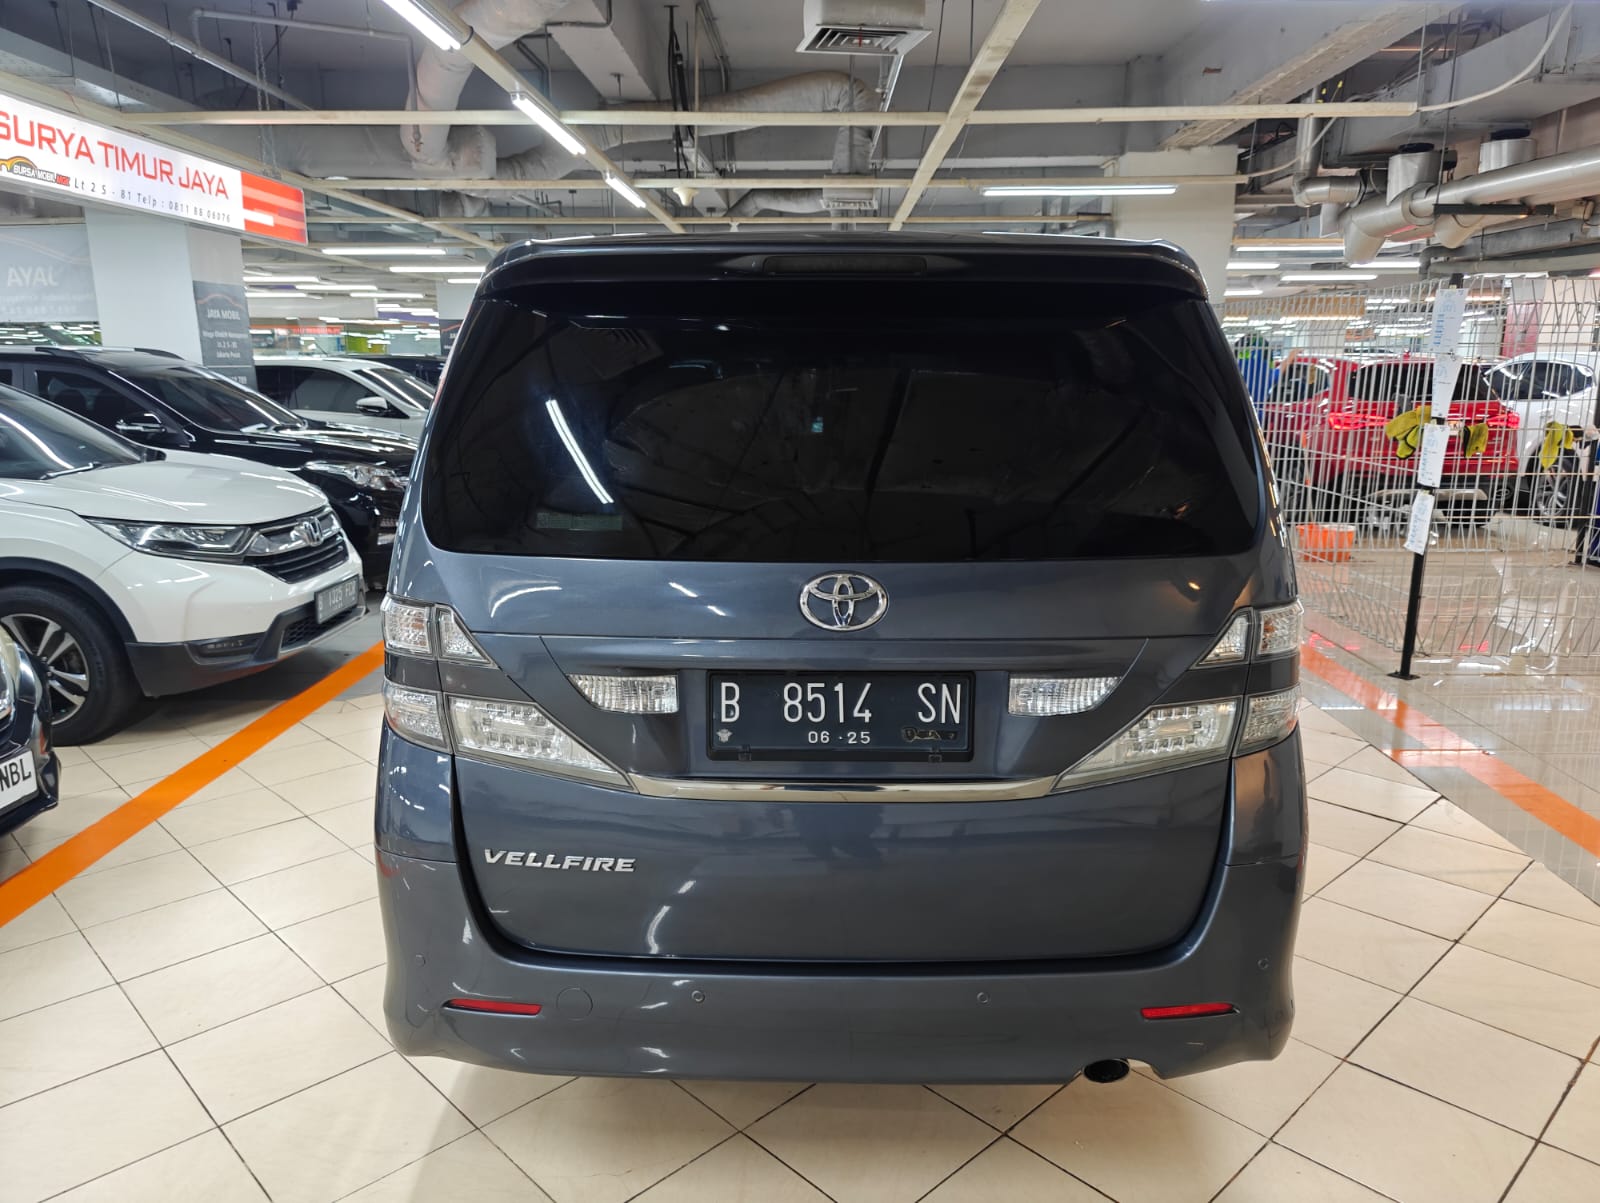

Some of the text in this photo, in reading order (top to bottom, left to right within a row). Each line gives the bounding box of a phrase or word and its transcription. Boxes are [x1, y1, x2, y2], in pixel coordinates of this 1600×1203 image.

[0, 111, 229, 200] SURYA TIMUR JAYA
[137, 192, 157, 208] Telp
[720, 682, 961, 724] B 8514 SN
[808, 731, 871, 744] 06 25
[484, 848, 636, 872] VELLFIRE
